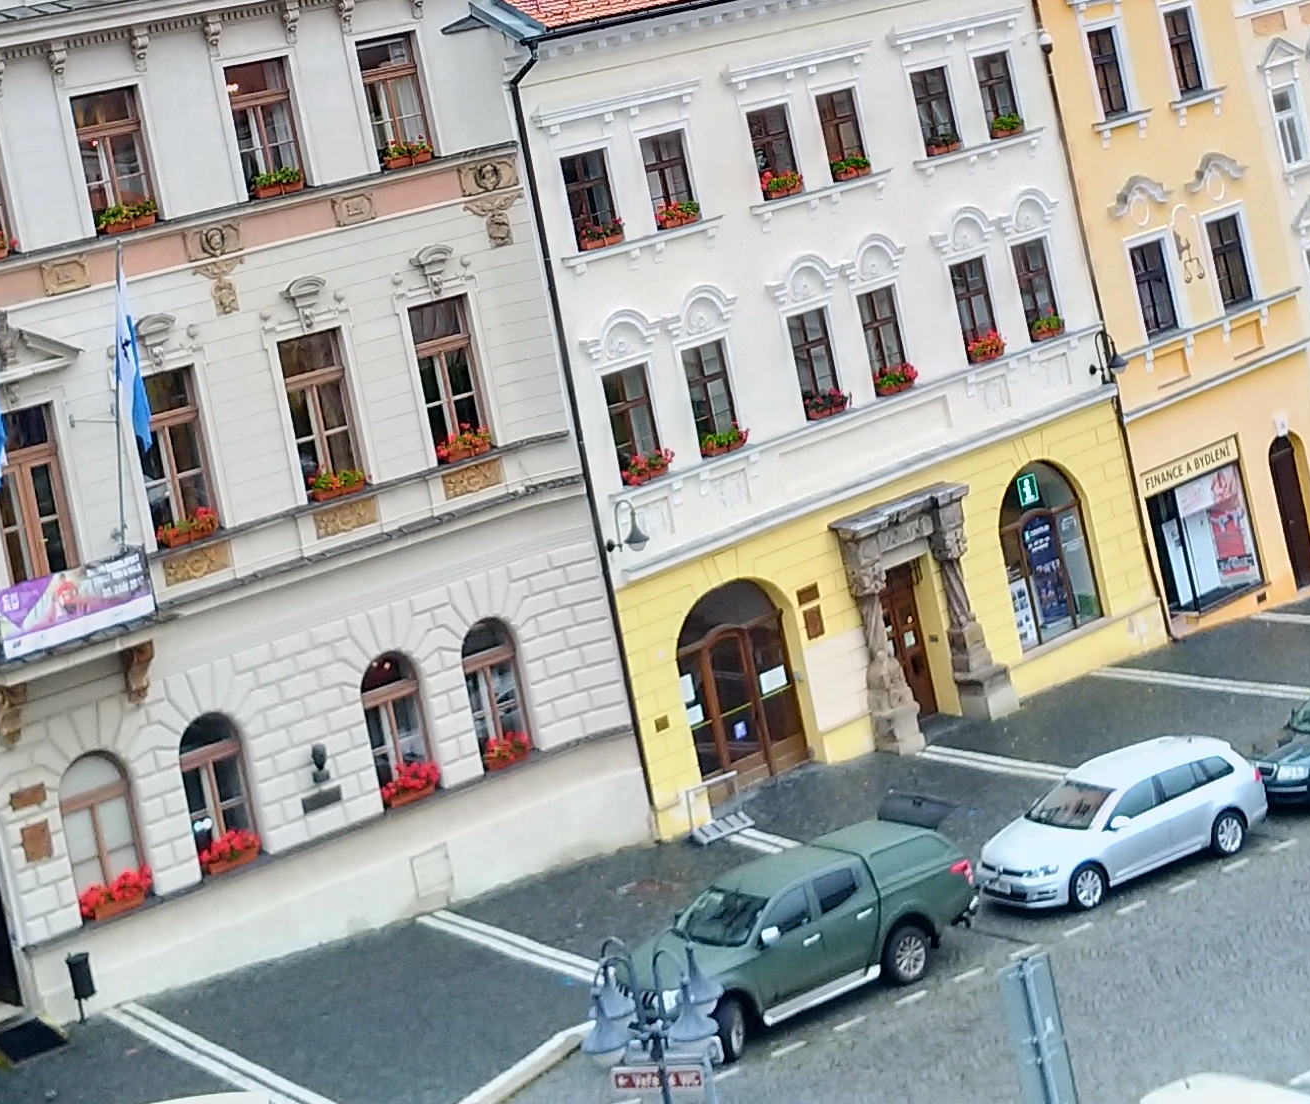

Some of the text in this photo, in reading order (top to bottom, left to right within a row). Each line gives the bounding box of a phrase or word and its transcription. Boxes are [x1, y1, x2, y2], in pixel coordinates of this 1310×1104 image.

[1145, 441, 1231, 491] FINANCE A BYDLENÍ
